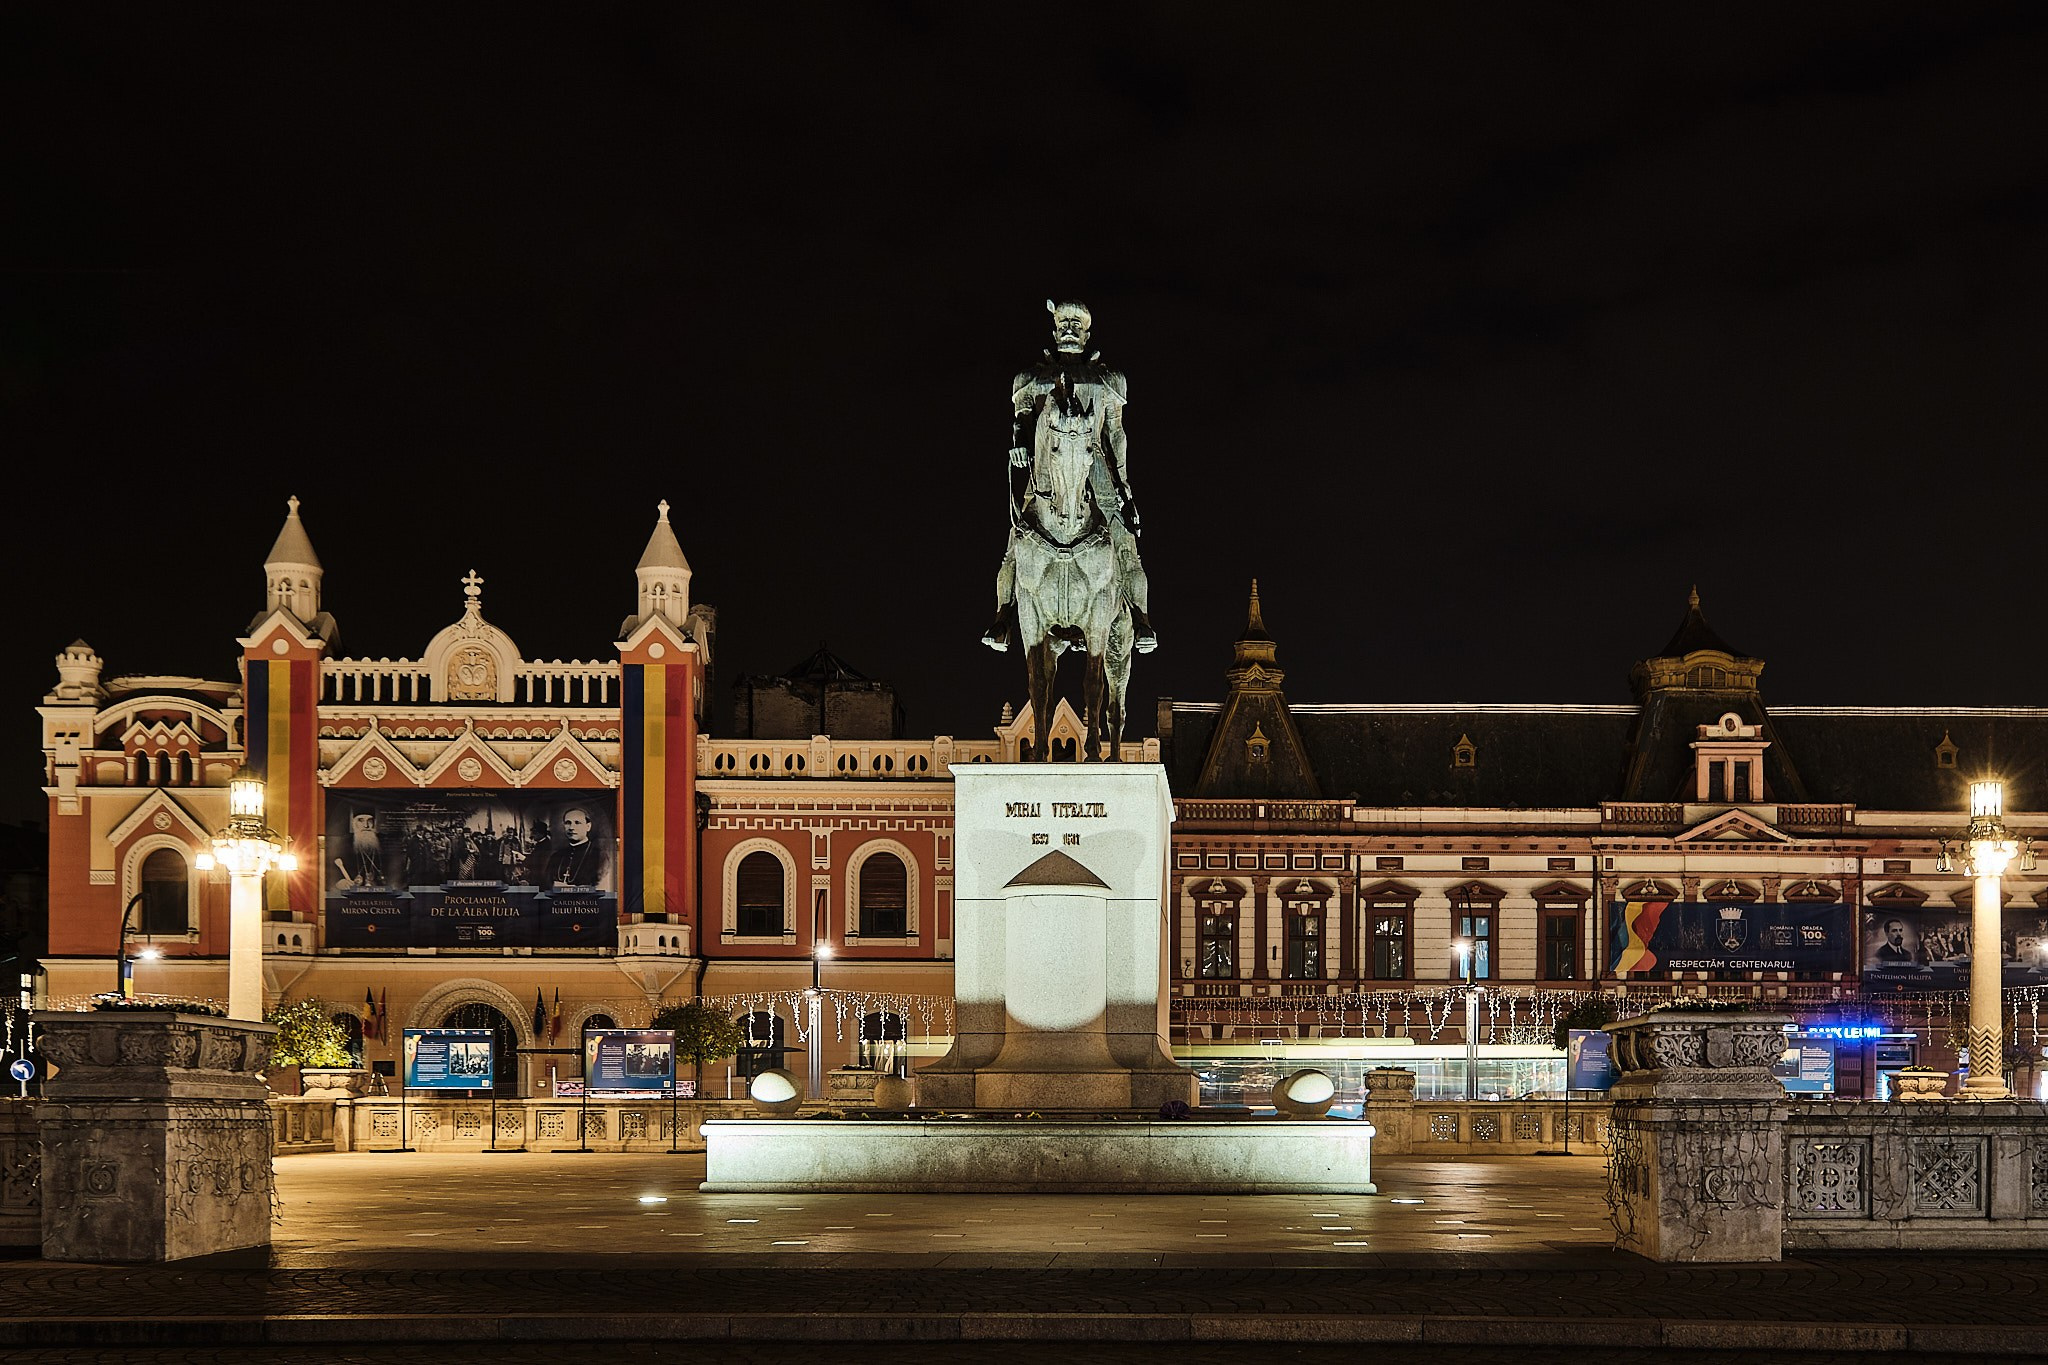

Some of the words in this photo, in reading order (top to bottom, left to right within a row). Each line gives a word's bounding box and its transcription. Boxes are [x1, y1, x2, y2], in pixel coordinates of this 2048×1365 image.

[1005, 802, 1041, 818] MIHAI
[1051, 802, 1108, 818] VITEAZUL
[341, 907, 368, 915] MIRON
[370, 907, 401, 915] CRISTEA
[431, 907, 445, 916] DE
[448, 907, 461, 916] LA
[462, 906, 489, 916] ALBA
[492, 906, 520, 916] IULIA
[551, 906, 572, 914] IULIU
[574, 906, 600, 914] HOSSU
[1803, 931, 1822, 939] 100
[1669, 959, 1725, 969] RESPECTĂM
[1729, 960, 1795, 969] CENTENARUL!
[1844, 1027, 1881, 1038] LEUMI
